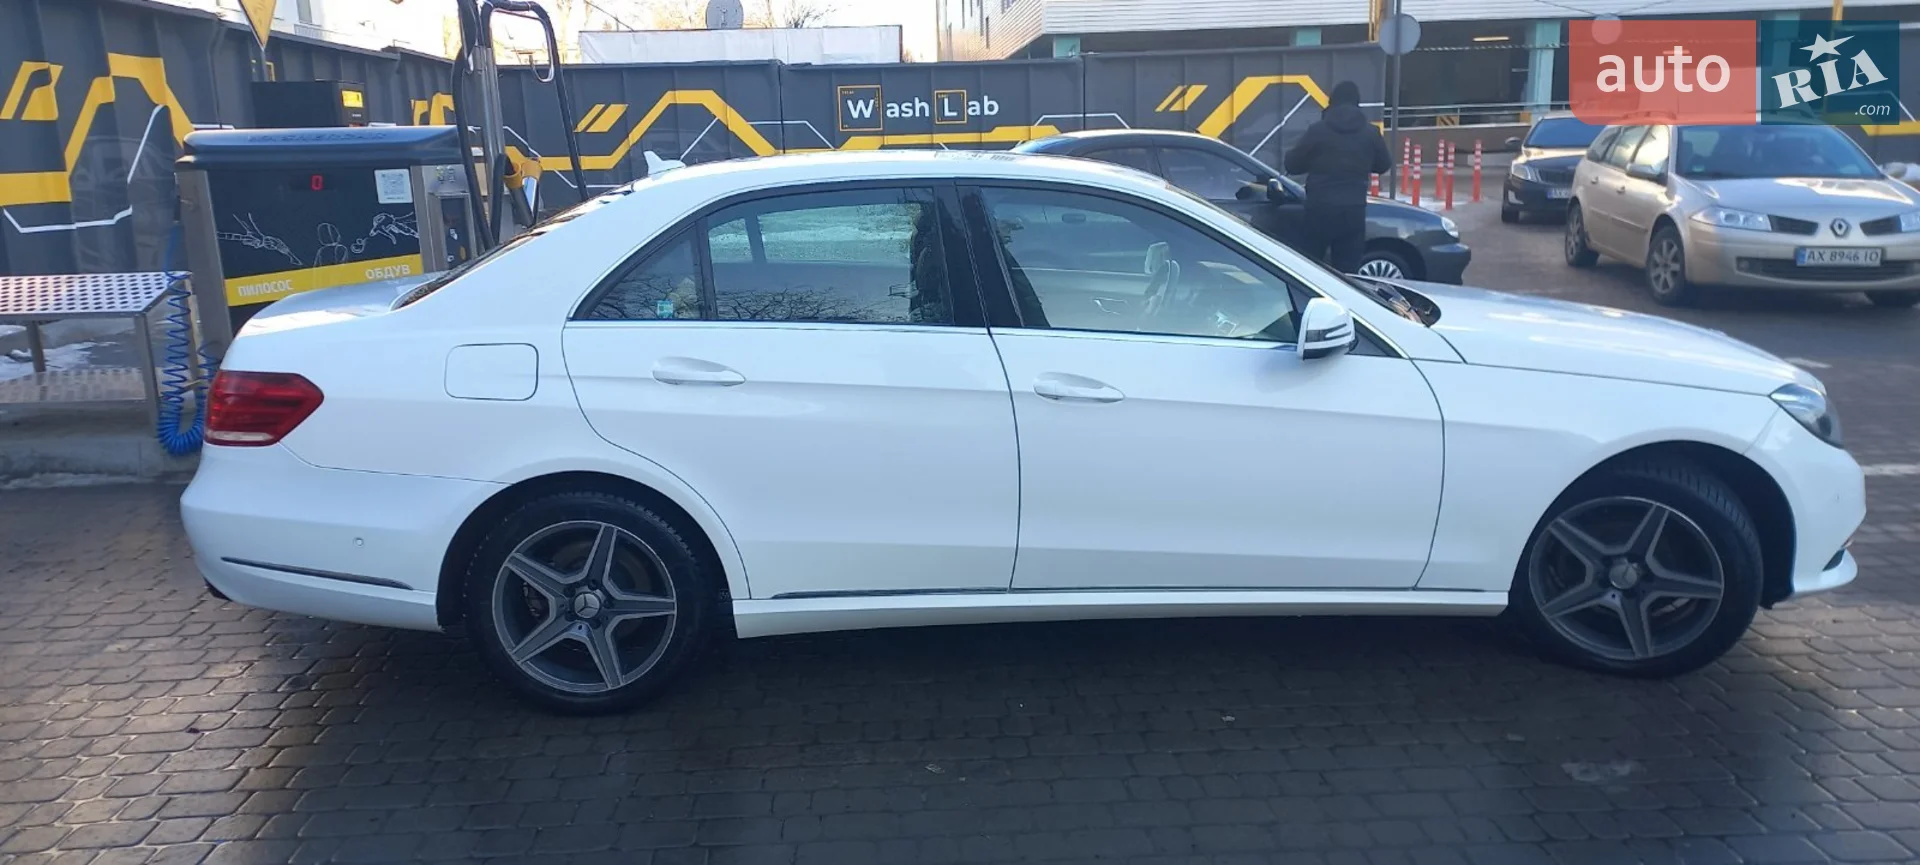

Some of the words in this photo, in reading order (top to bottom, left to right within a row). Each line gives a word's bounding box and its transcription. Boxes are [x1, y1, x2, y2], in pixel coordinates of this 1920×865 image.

[1807, 250, 1825, 261] AX
[1829, 250, 1860, 261] 8946
[364, 264, 412, 280] ОБДУВ
[237, 279, 294, 297] ПИЛОСОС
